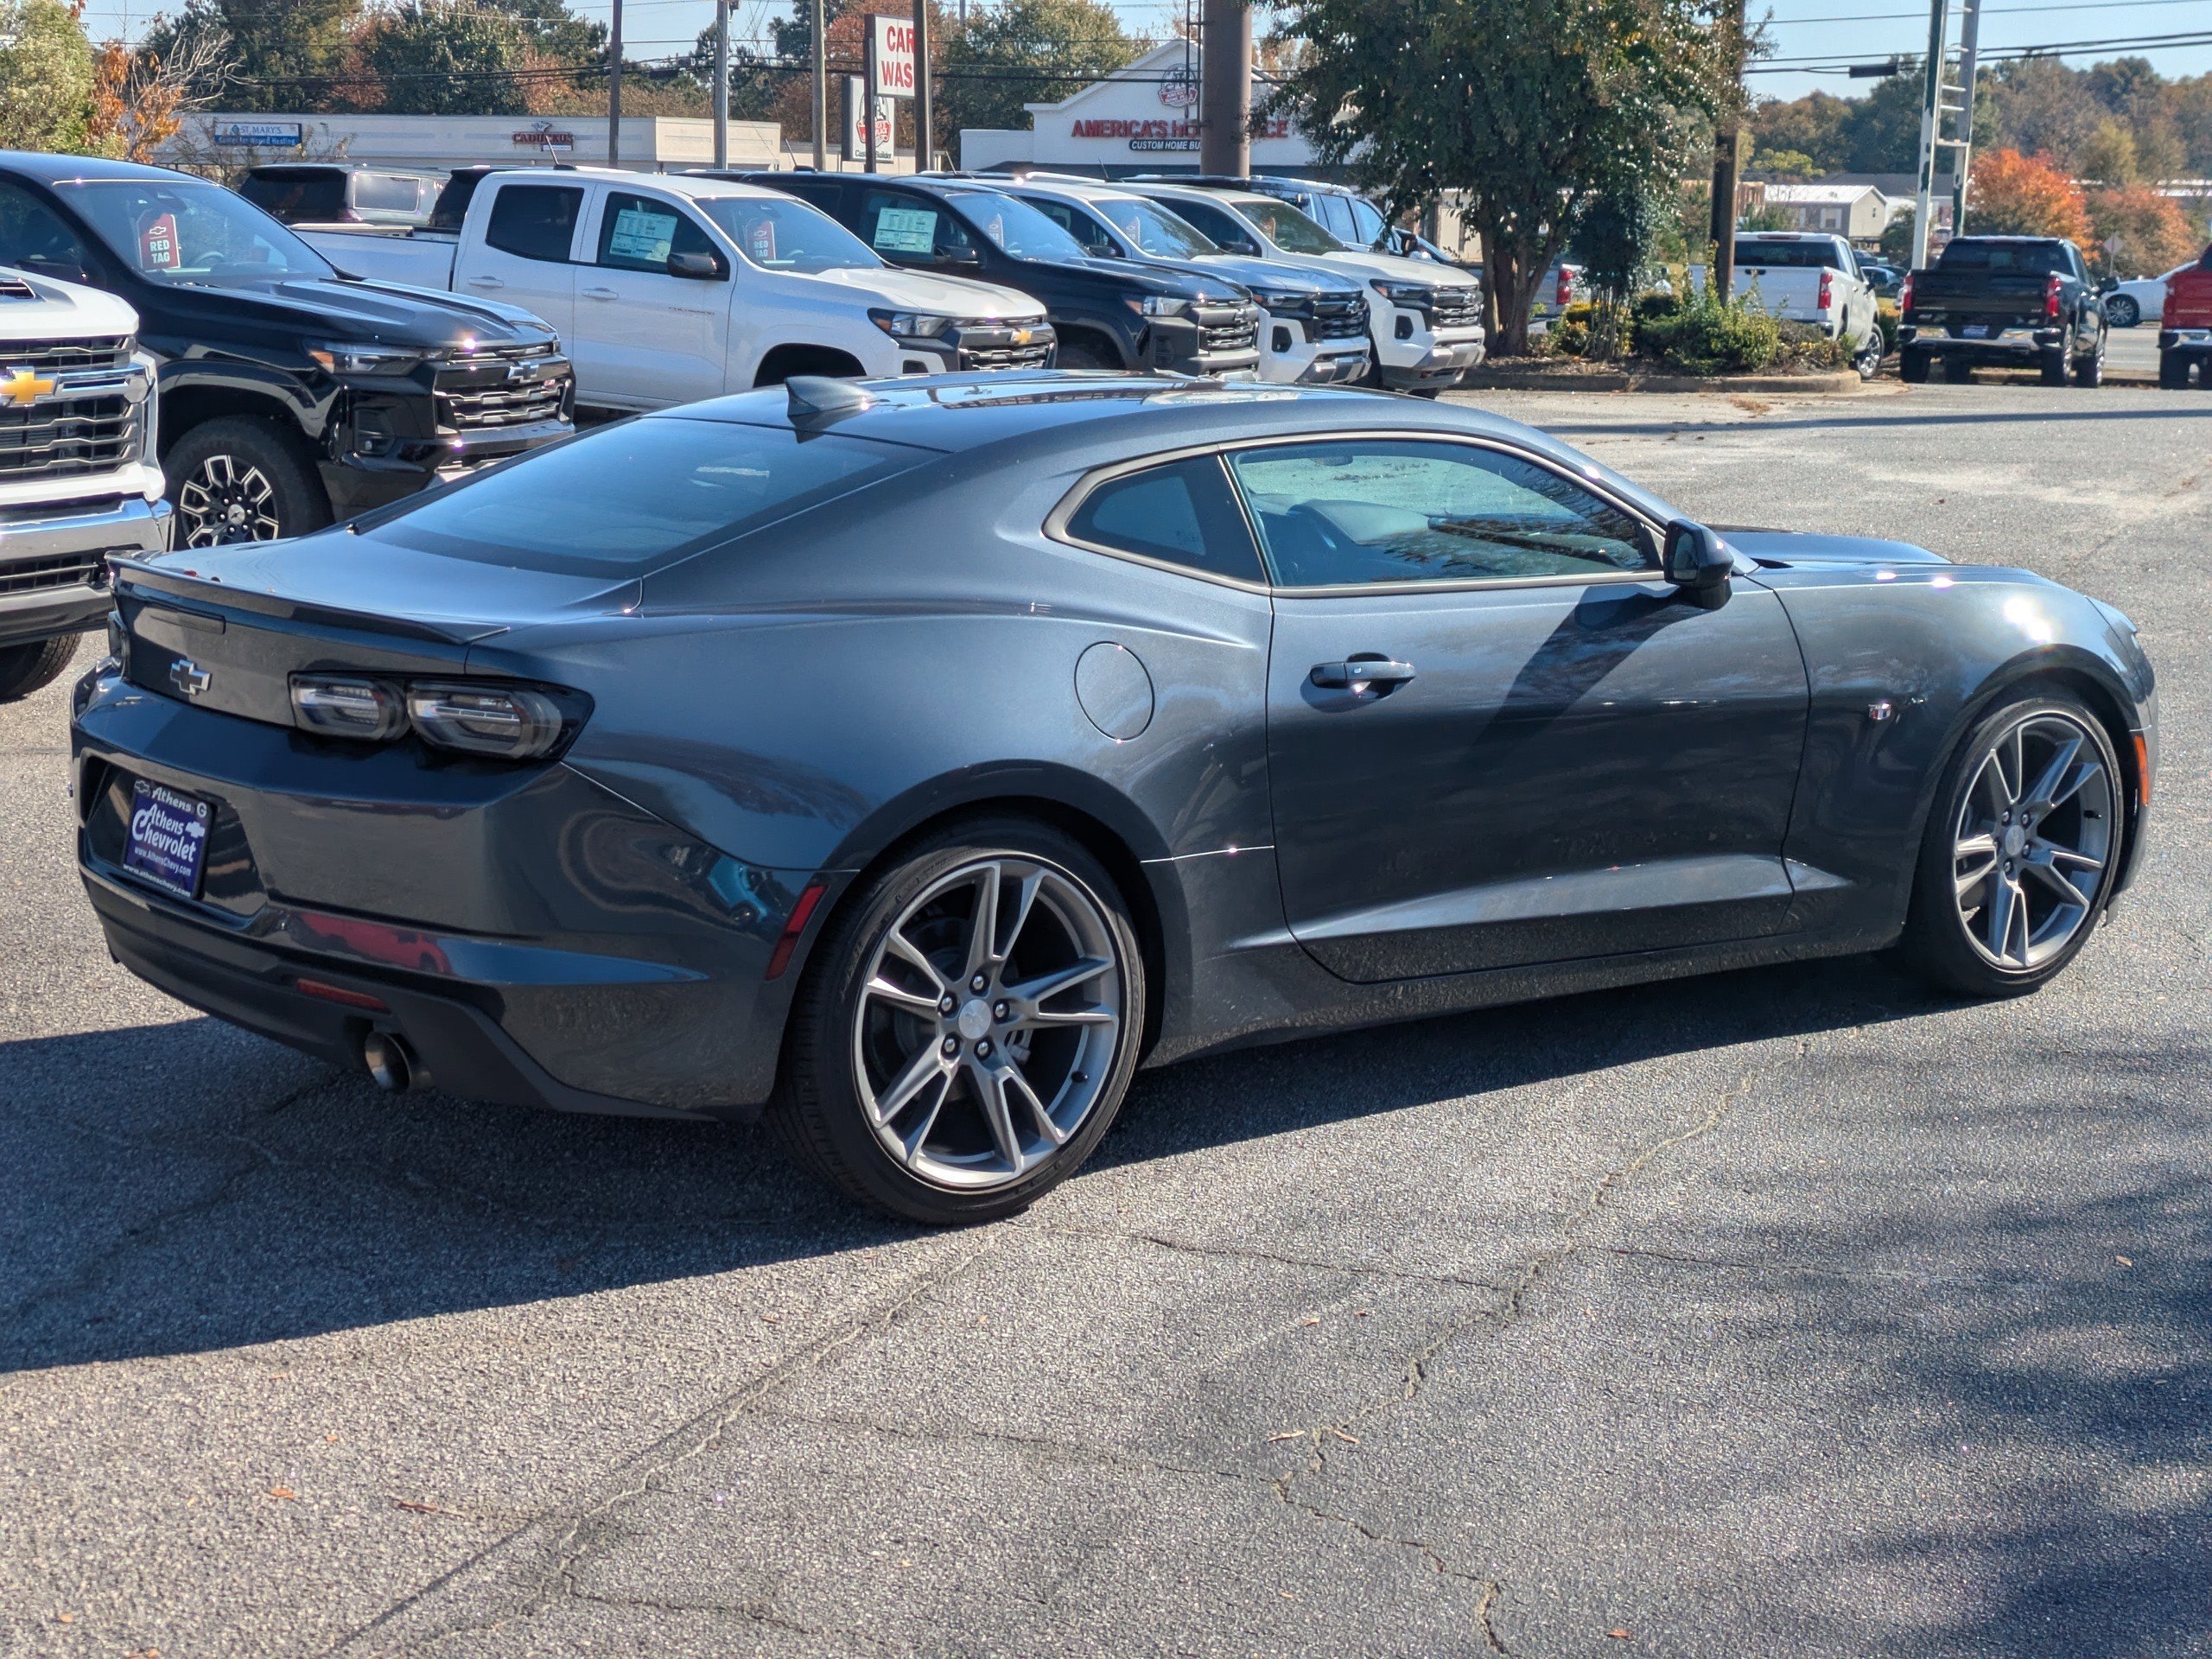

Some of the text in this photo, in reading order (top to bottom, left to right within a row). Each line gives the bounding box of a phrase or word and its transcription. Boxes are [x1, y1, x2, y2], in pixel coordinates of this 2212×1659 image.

[887, 25, 916, 54] CAR
[881, 60, 914, 88] WAS
[1071, 119, 1199, 138] AMERICA'S HO
[1131, 140, 1202, 149] CUSTOM HOME BU
[149, 239, 170, 251] RED
[753, 240, 768, 249] RED
[754, 249, 768, 257] TAG
[151, 251, 170, 264] TAG
[151, 786, 192, 812] Athens
[140, 803, 185, 836] Athens
[131, 809, 198, 863] Chevrolet
[134, 846, 193, 877] www.AthensChevy.com
